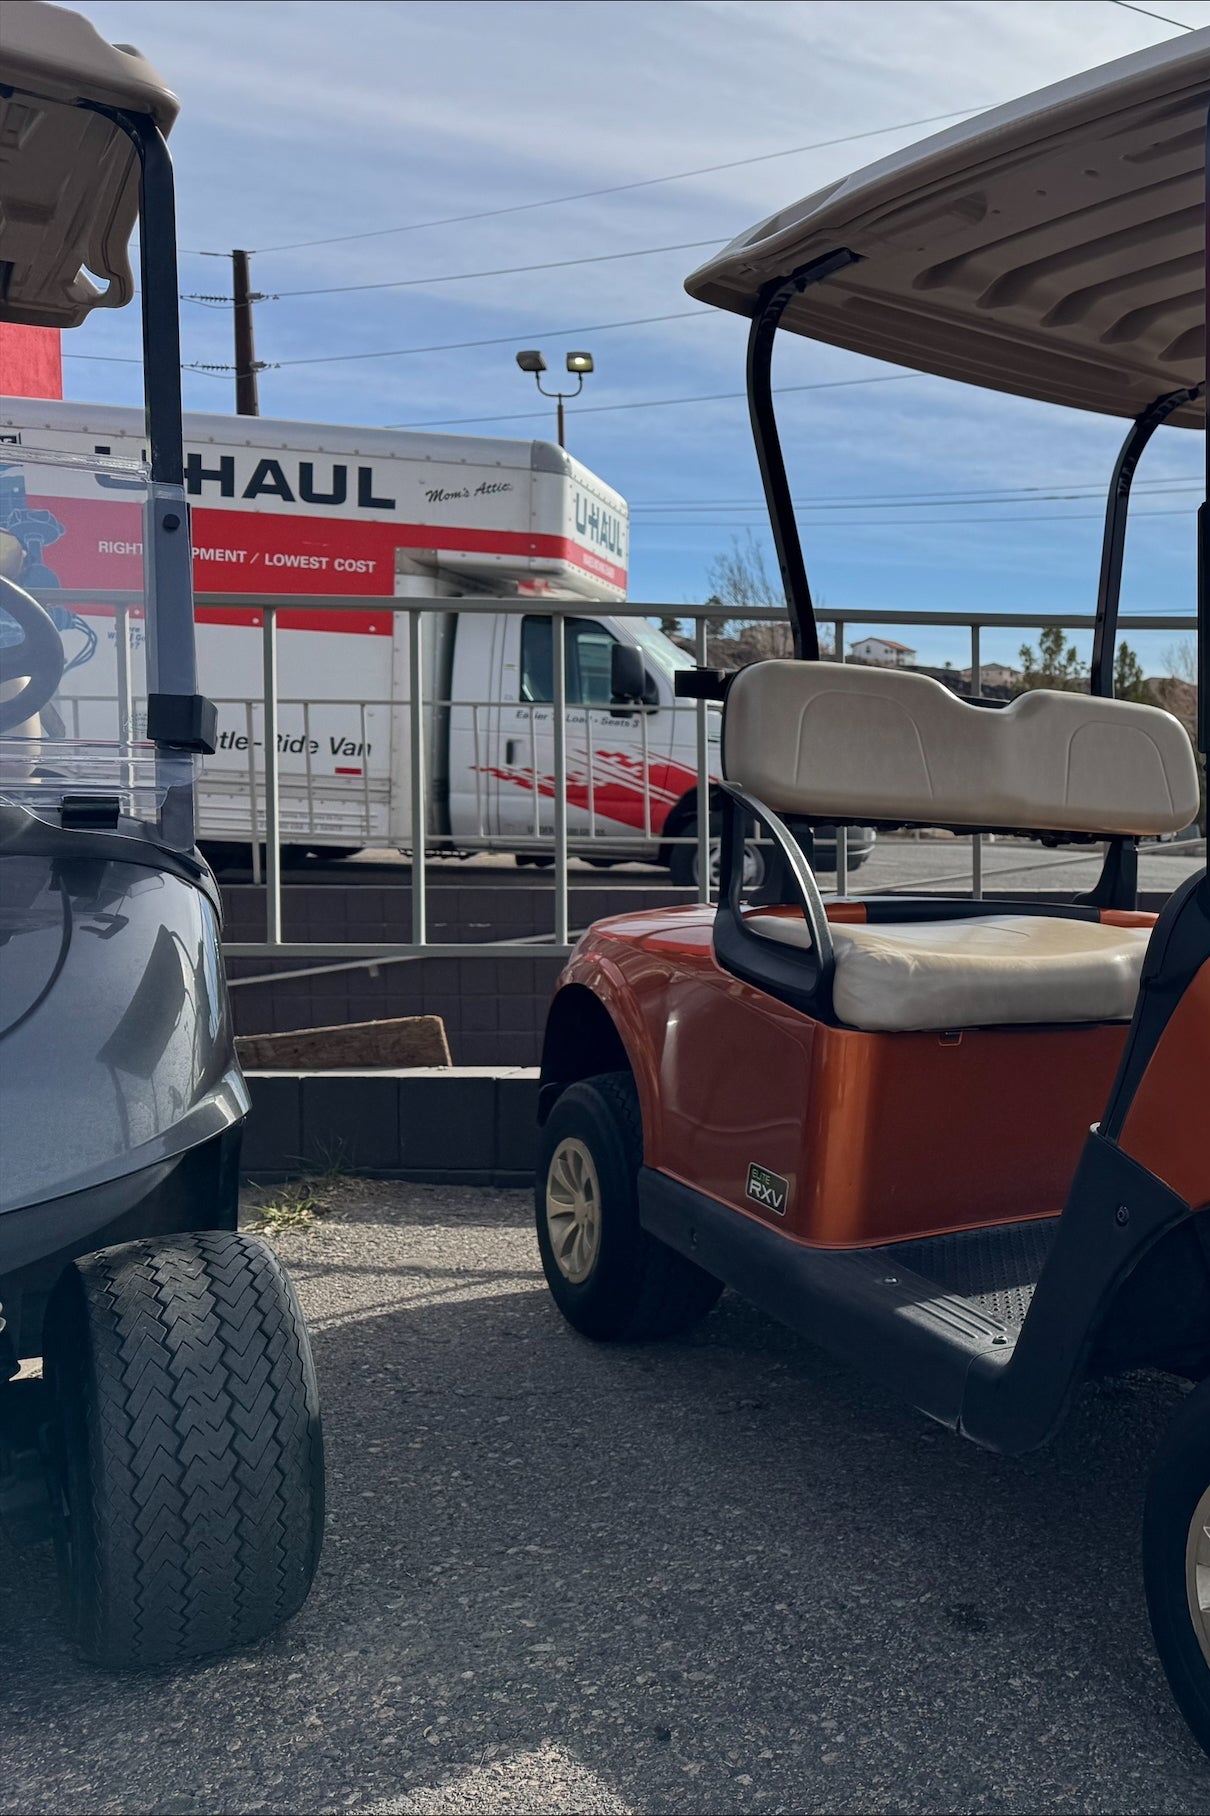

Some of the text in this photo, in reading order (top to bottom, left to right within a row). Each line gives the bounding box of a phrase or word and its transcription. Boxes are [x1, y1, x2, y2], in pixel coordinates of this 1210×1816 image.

[94, 446, 396, 510] UHAUL
[425, 487, 470, 503] Mom's
[575, 492, 623, 557] U-HAUL
[98, 540, 144, 556] RIGHT
[192, 547, 247, 565] PMENT
[264, 553, 329, 571] LOWEST
[333, 559, 376, 574] COST
[515, 709, 548, 721] Eaier
[566, 713, 593, 724] Loa
[215, 730, 373, 758] tle-ide Van
[749, 1179, 783, 1208] RXV
